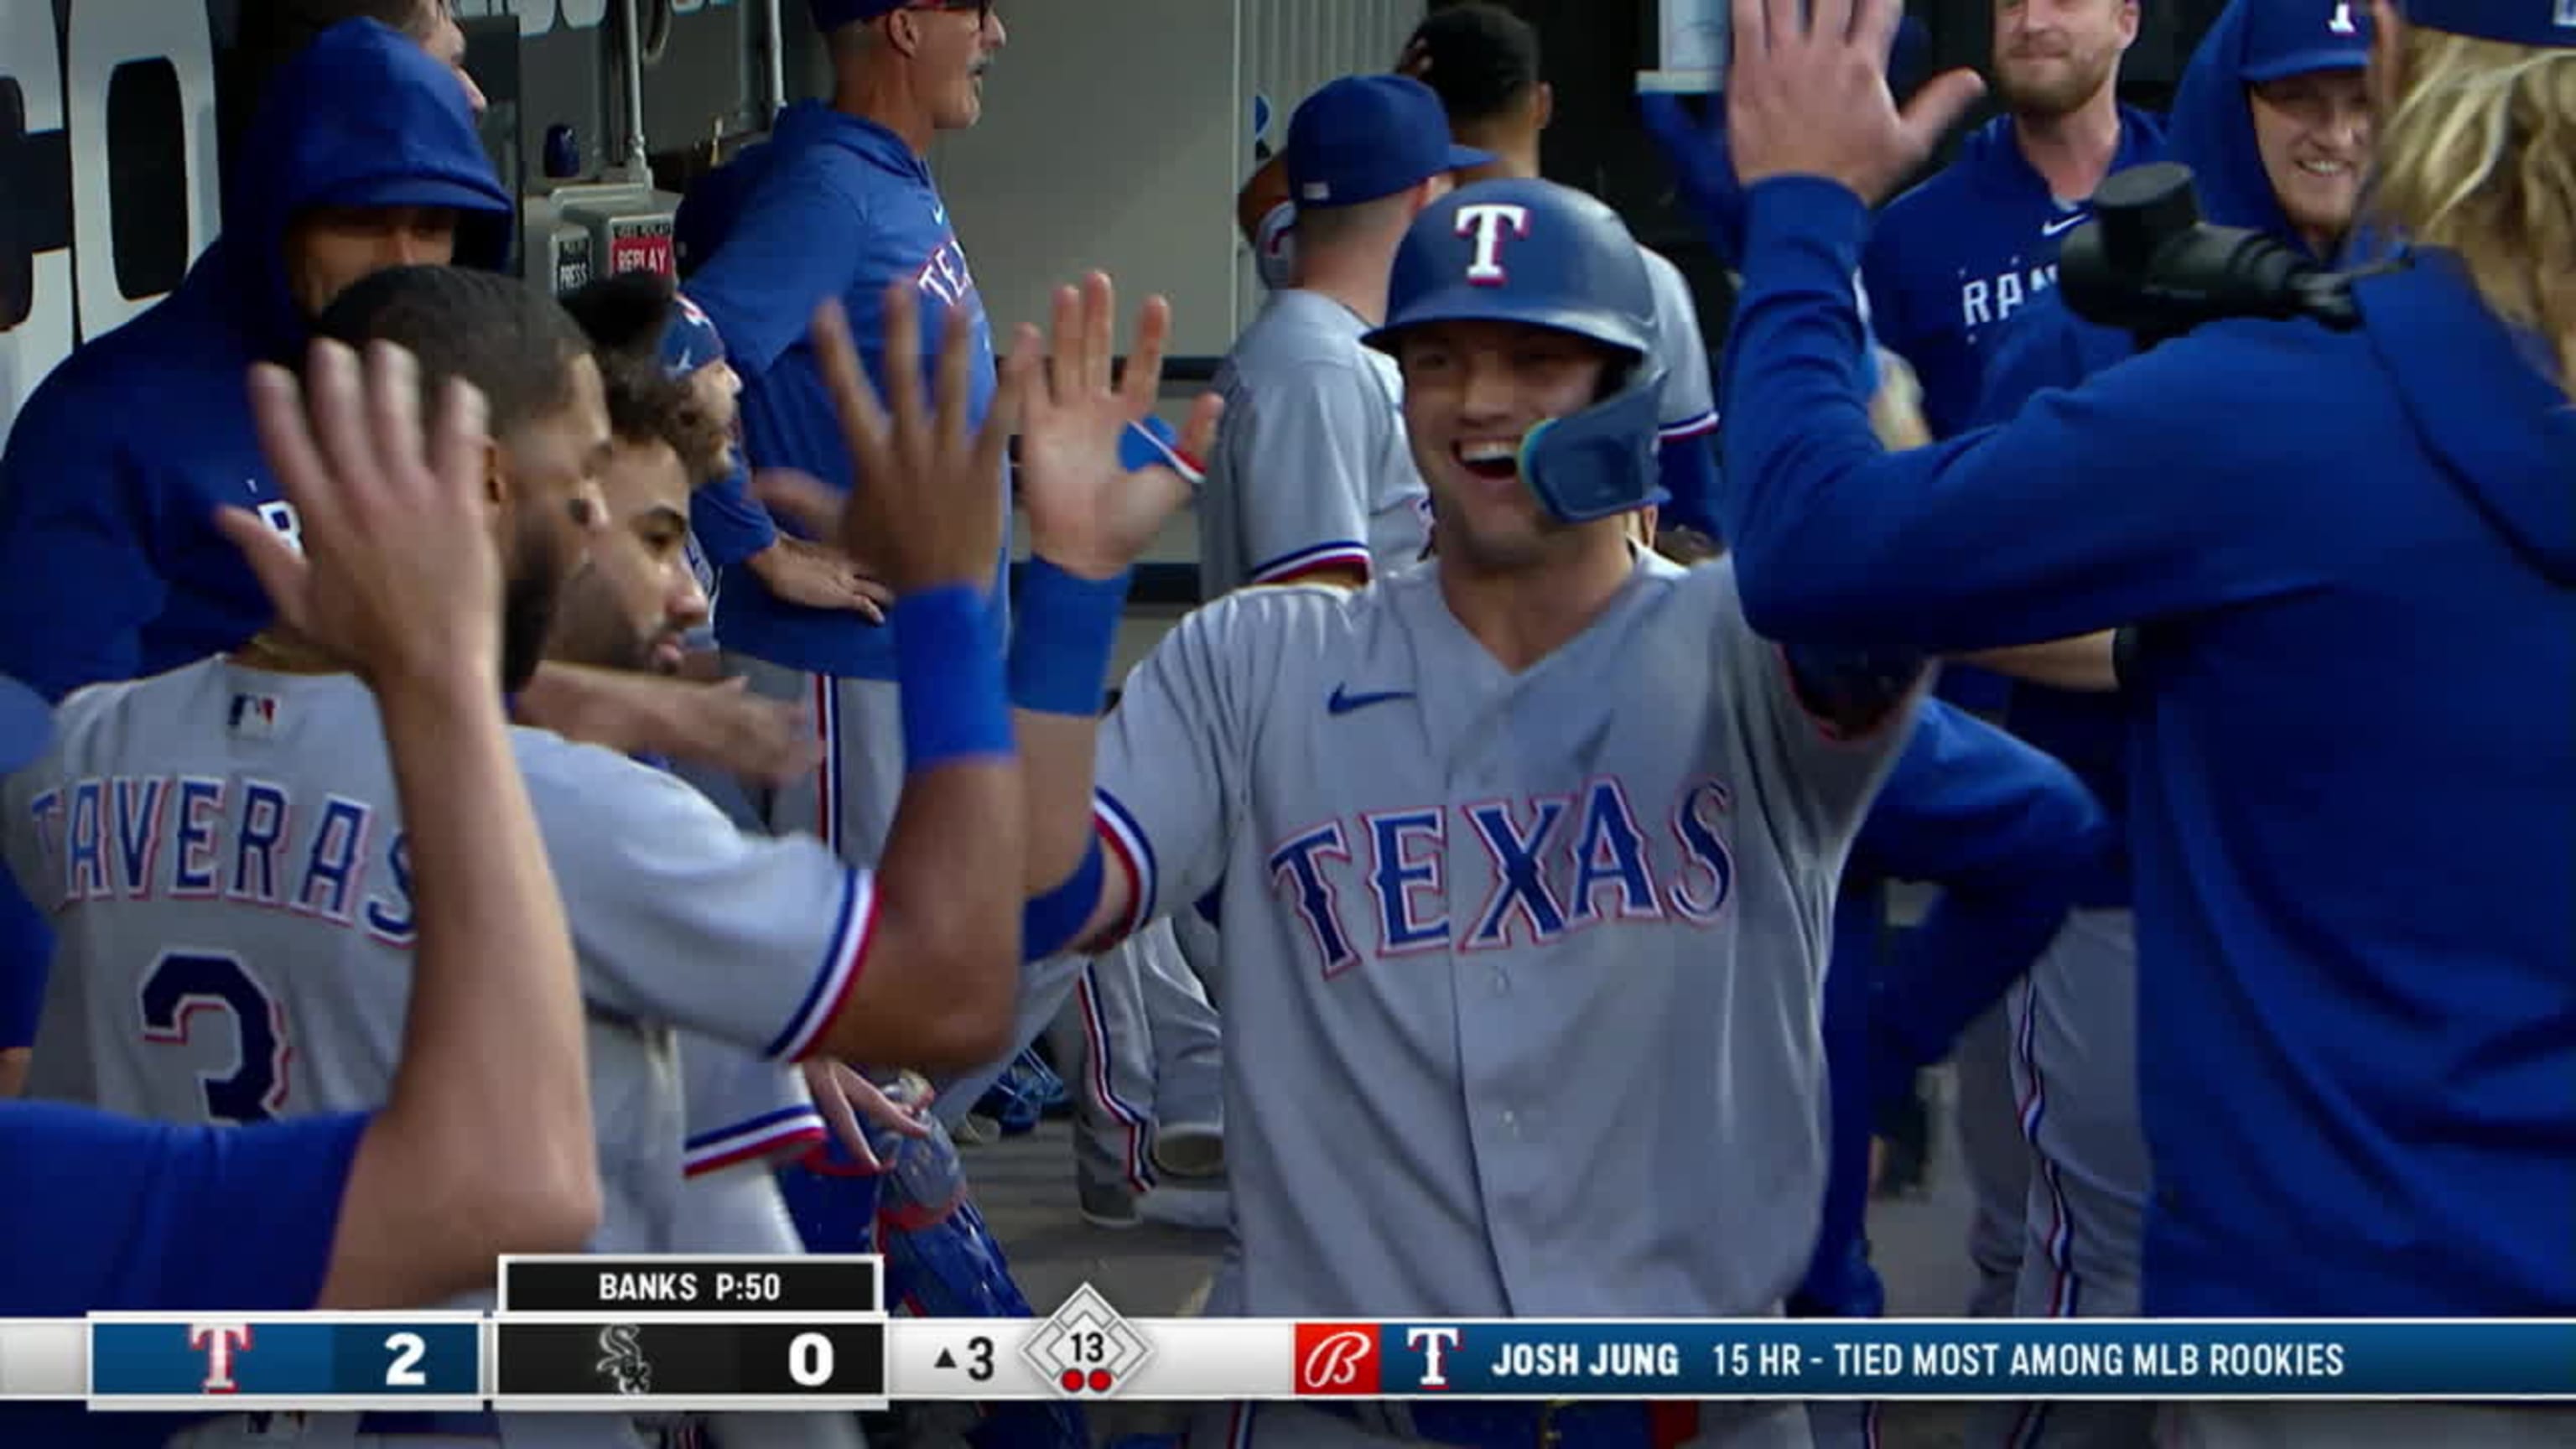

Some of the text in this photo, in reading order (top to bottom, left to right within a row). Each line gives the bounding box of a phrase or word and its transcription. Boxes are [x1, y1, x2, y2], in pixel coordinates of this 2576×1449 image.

[617, 246, 668, 275] REPLAY
[1454, 204, 1531, 286] T
[30, 775, 418, 949] TAVERAS
[1268, 772, 1739, 981] TEXAS
[139, 948, 290, 1125] 3
